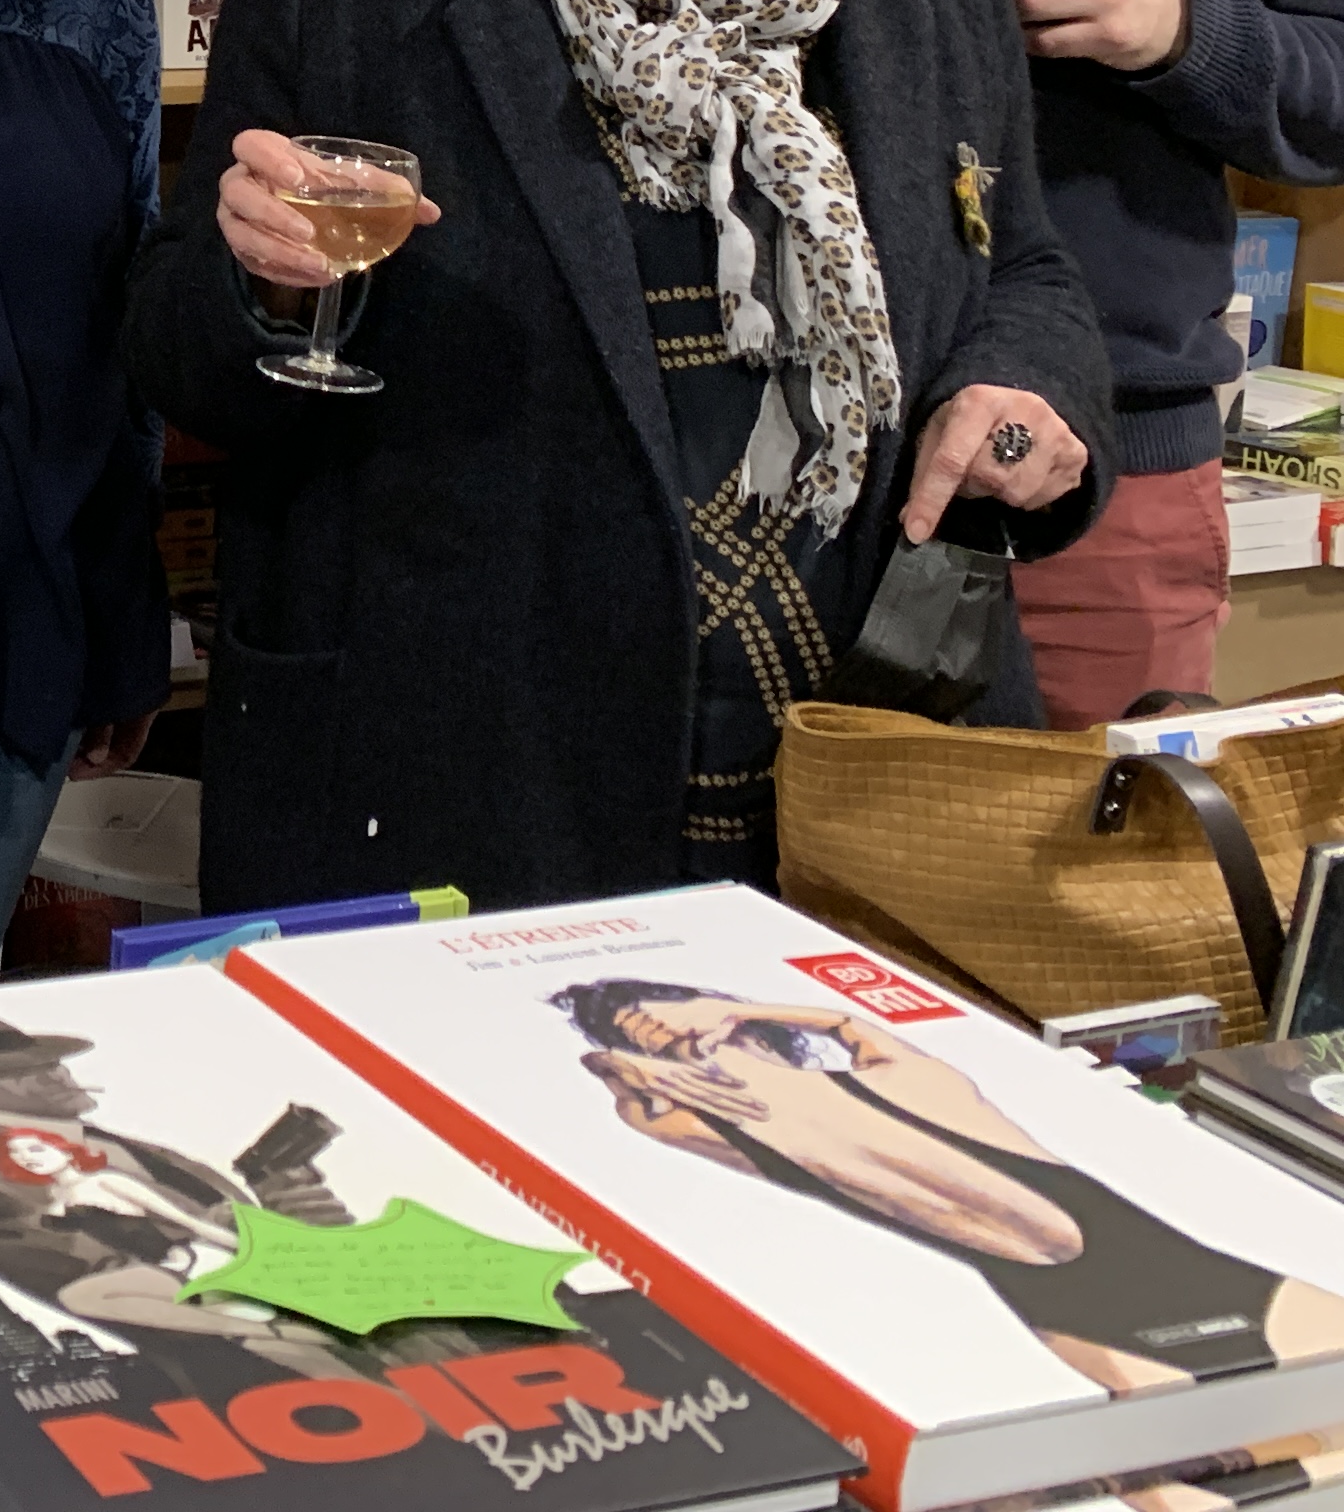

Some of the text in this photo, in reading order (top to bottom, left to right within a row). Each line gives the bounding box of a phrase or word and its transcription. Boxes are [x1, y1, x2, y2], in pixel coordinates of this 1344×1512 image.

[438, 917, 651, 955] L'ÉTREINTE
[827, 964, 878, 985] BD
[857, 987, 942, 1016] RTL
[41, 1342, 663, 1498] NOIR
[463, 1376, 750, 1491] Burlesque
